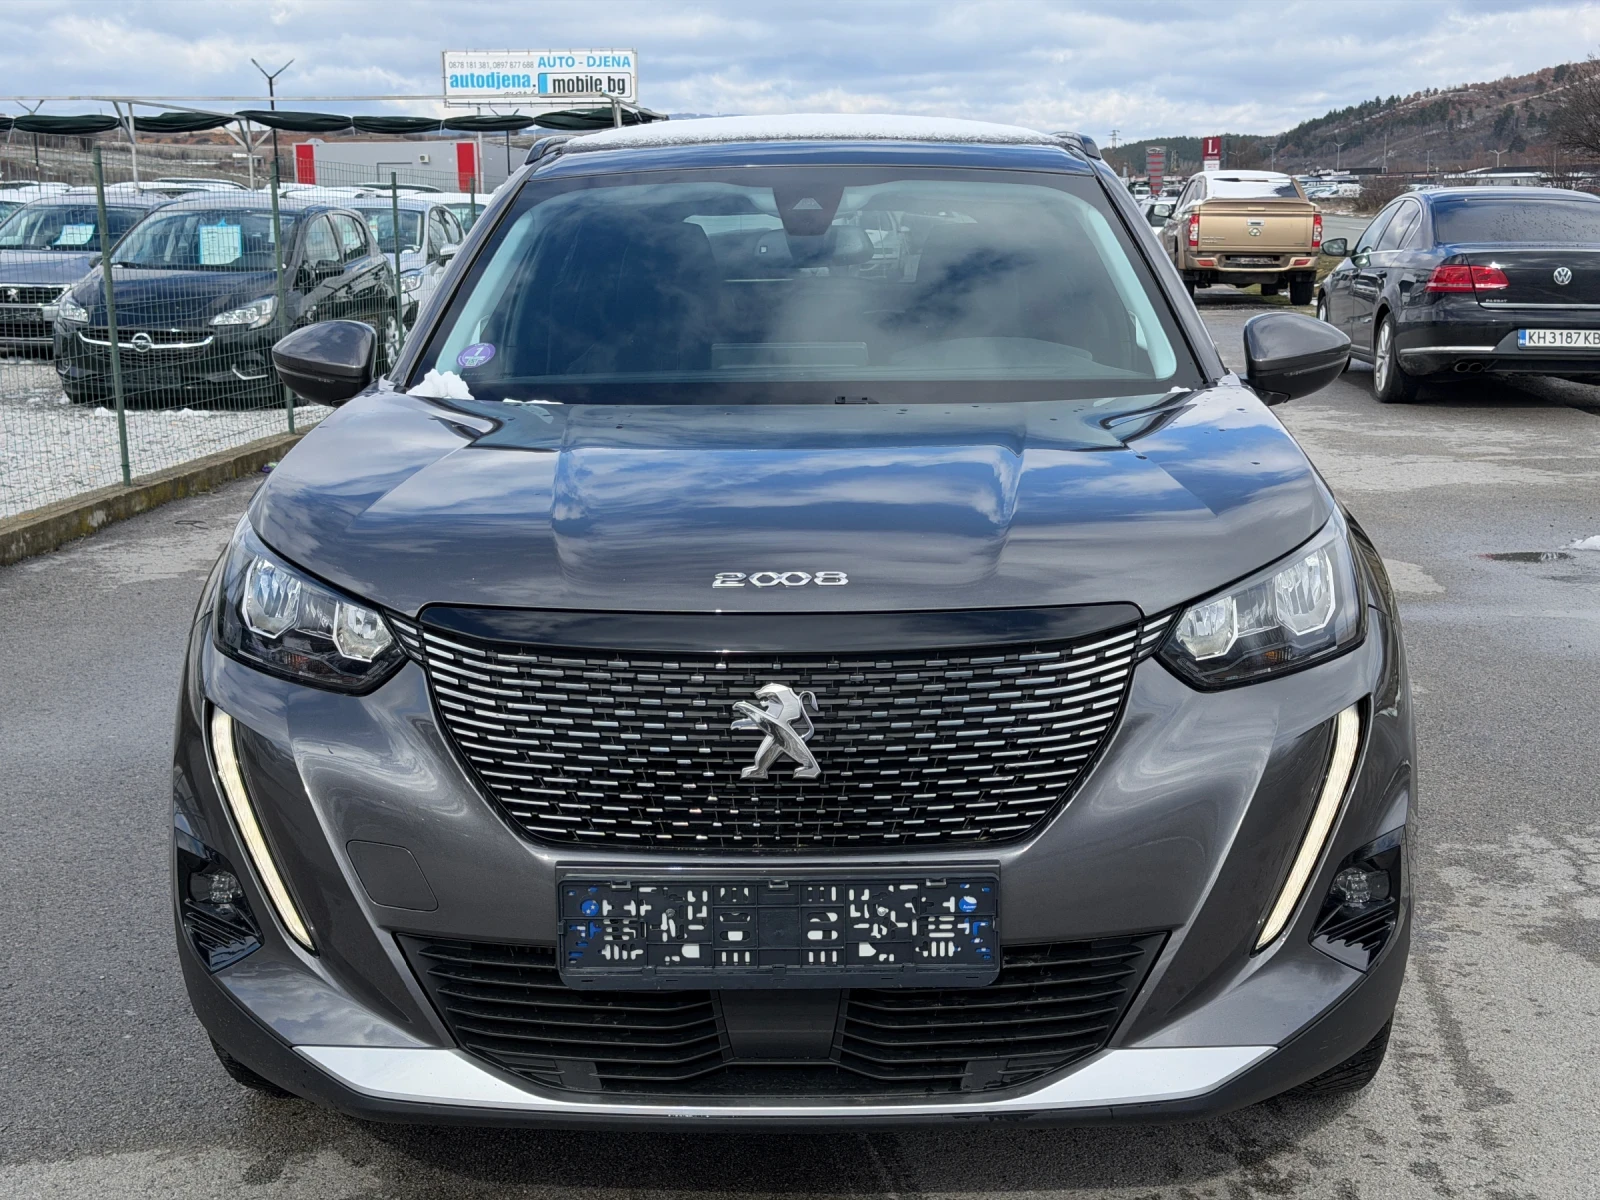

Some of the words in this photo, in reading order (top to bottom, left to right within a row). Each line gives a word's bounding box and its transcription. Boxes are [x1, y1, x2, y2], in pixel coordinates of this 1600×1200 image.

[449, 61, 464, 69] 0878
[466, 61, 477, 69] 181
[493, 61, 508, 69] 0897
[510, 61, 521, 69] 877
[522, 61, 534, 69] 688
[538, 56, 575, 68] AUTO
[587, 55, 631, 68] DJENA
[552, 75, 626, 95] mobile.bg
[1208, 139, 1218, 154] L
[711, 571, 849, 589] 2008
